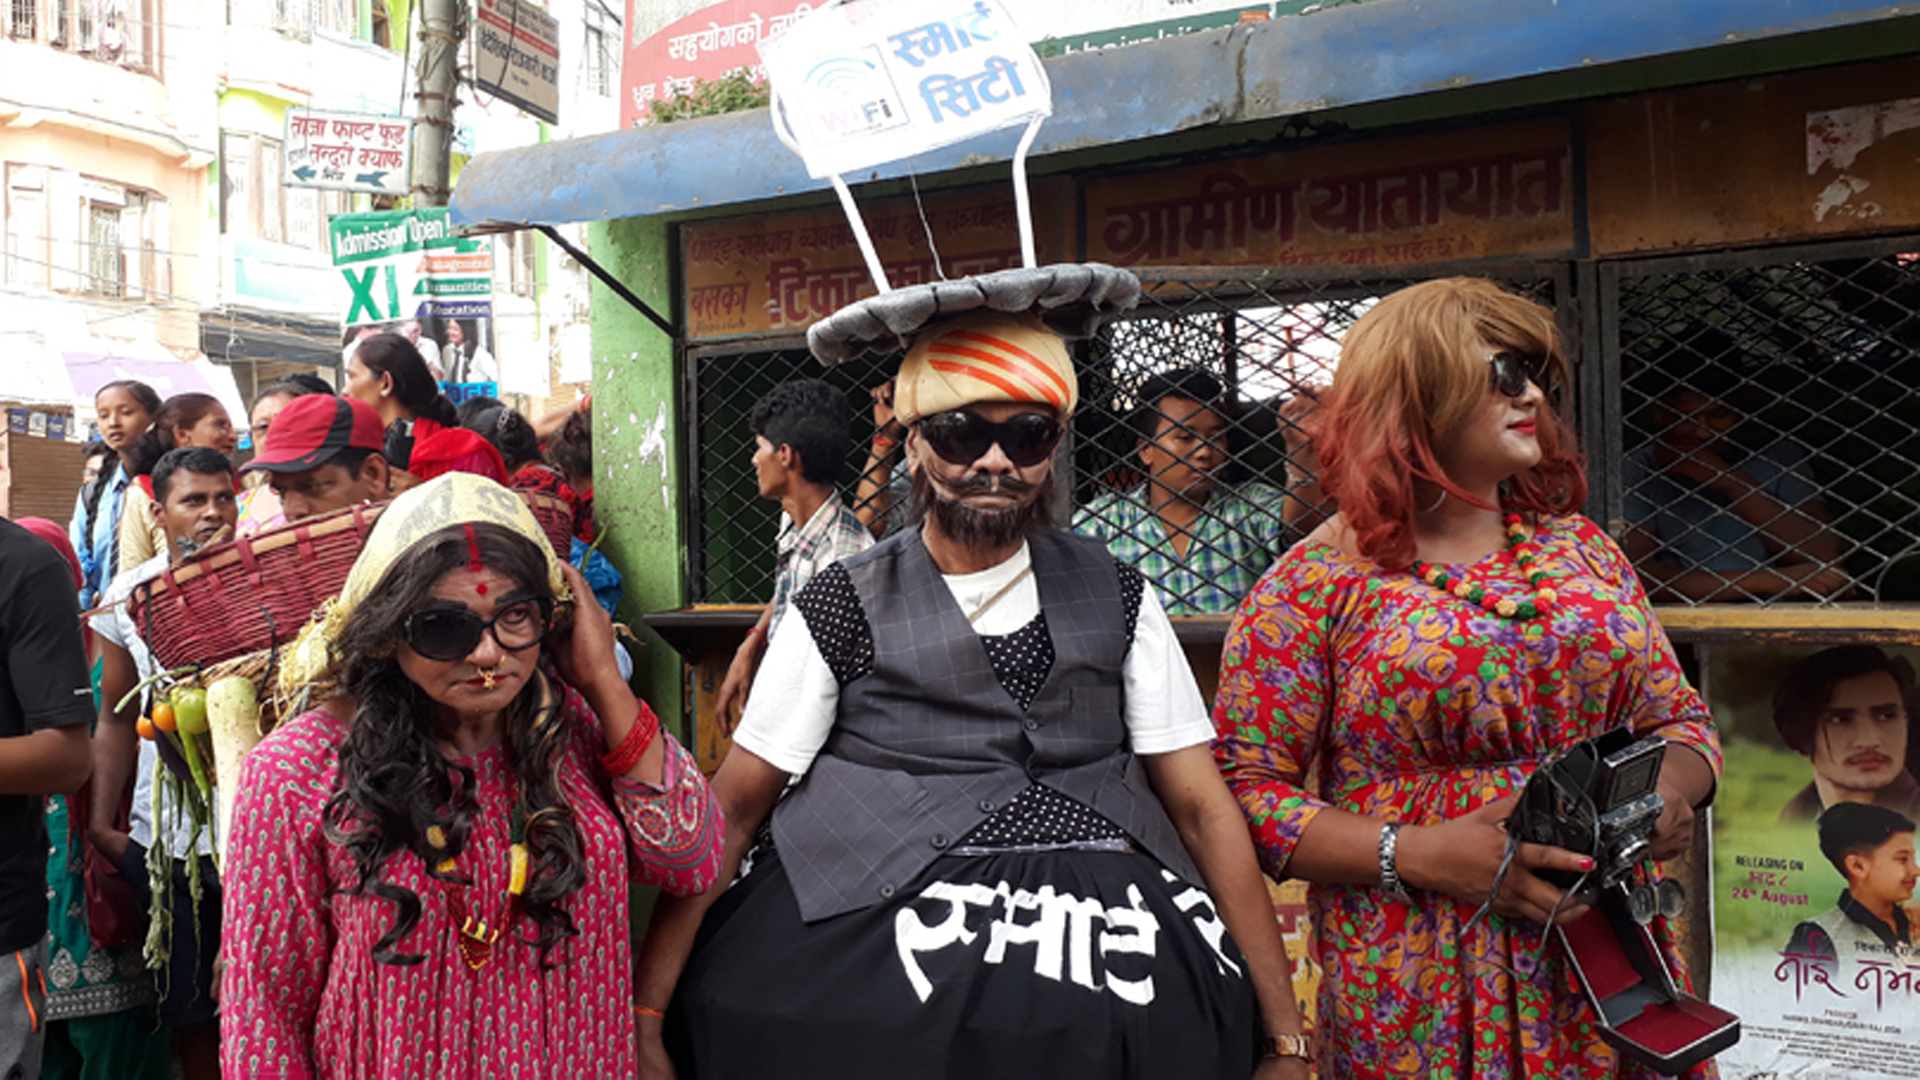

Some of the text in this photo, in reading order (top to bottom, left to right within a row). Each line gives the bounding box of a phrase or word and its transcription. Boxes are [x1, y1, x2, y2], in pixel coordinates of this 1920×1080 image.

[668, 13, 762, 61] सहयोगको
[918, 56, 1026, 123] सिटी
[291, 116, 328, 137] ताजा
[820, 98, 893, 132] WiFi
[1102, 148, 1570, 267] ग्रामीण यातायात
[336, 218, 407, 259] Admission
[409, 216, 444, 247] Open
[341, 265, 402, 324] XI
[422, 279, 490, 293] Humanities
[691, 269, 751, 320] बसको
[426, 302, 489, 316] Education
[1736, 855, 1804, 871] RELEASING ON
[1761, 889, 1809, 907] August
